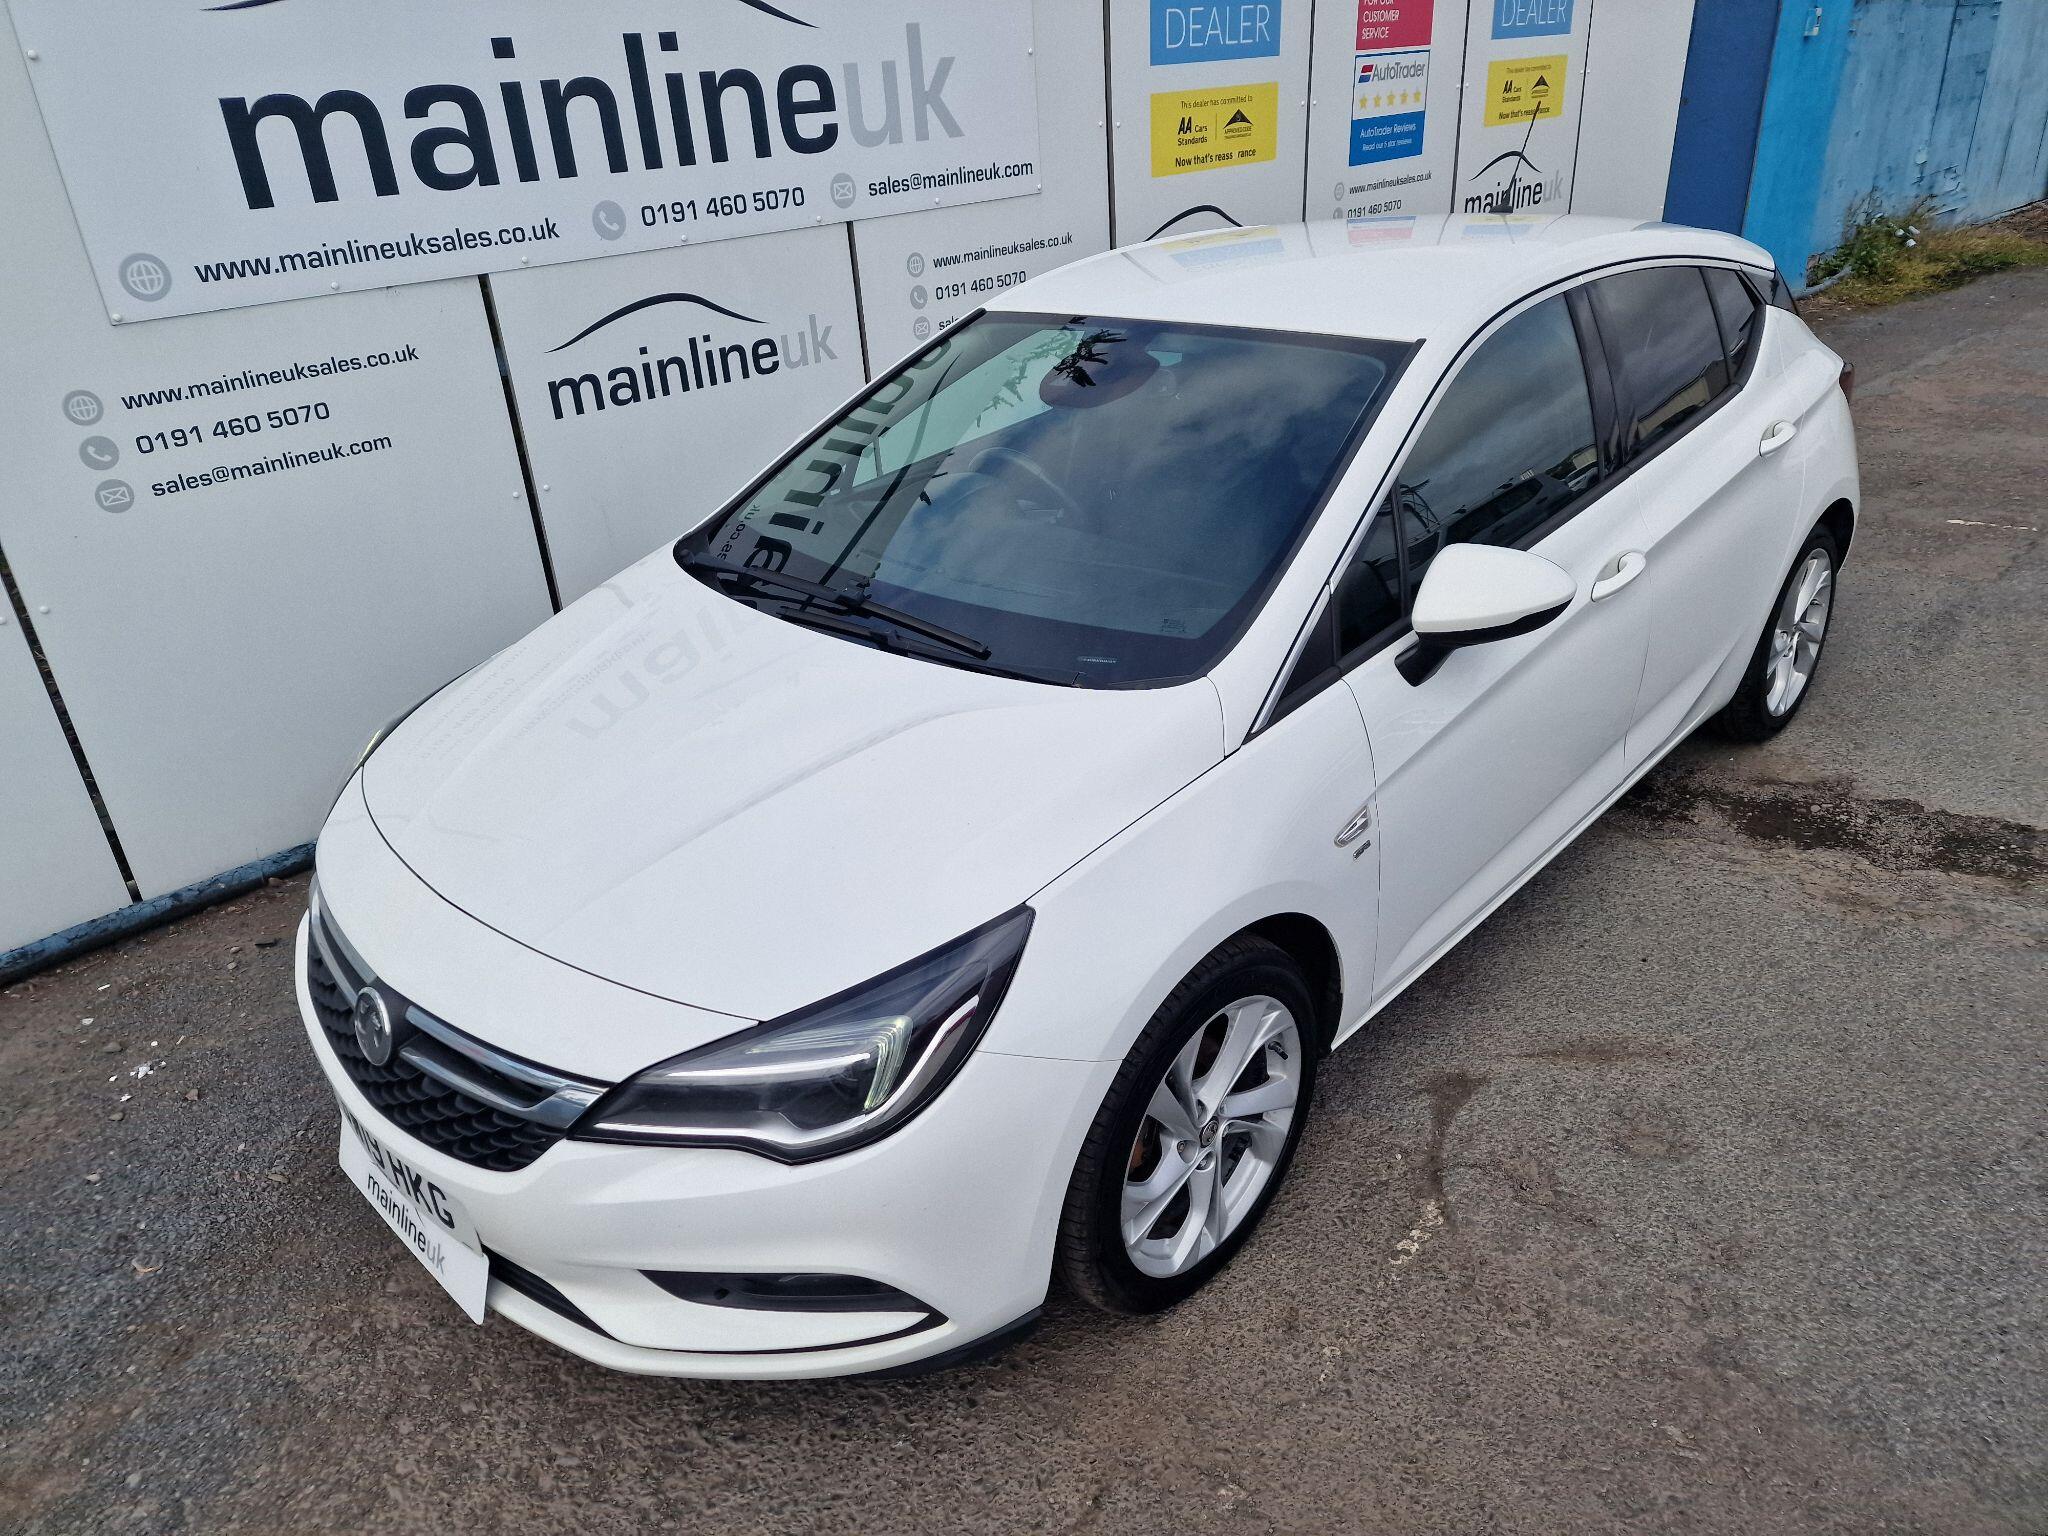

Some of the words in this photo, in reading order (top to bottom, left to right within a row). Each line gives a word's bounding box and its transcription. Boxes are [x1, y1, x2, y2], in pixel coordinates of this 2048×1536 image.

[1165, 4, 1271, 49] DEALER
[1363, 10, 1400, 23] CUSTOMER
[1501, 0, 1567, 27] DEALER
[1362, 26, 1390, 40] SERVICE
[1372, 61, 1426, 82] AutoTrader
[219, 22, 964, 209] mainlineuk
[1181, 100, 1192, 109] This
[1193, 99, 1209, 108] dealer
[1210, 98, 1219, 106] has
[1220, 95, 1247, 105] committed
[1177, 116, 1192, 135] AA
[1194, 124, 1208, 133] Cars
[1177, 135, 1208, 146] Standards
[1360, 126, 1393, 139] AutoTrader
[1394, 122, 1417, 134] Reviews
[1175, 156, 1192, 168] Now
[1193, 152, 1214, 165] that's
[868, 160, 1034, 196] sales@mainlineuk.com
[1349, 170, 1432, 194] www.mainlineuksales.co.uk
[641, 197, 698, 227] 0191
[706, 194, 747, 218] 460
[753, 186, 805, 213] 5070
[1347, 206, 1366, 218] 0191
[1368, 203, 1382, 215] 460
[1383, 199, 1402, 212] 5070
[194, 218, 560, 283] www.mainlineuksales.co.uk
[932, 232, 1073, 270] www.mainlineuksales.co.uk
[935, 279, 967, 301] 0191
[970, 275, 995, 297] 460
[996, 270, 1027, 290] 5070
[121, 344, 419, 410] www.mainlineuksales.co.uk
[547, 314, 839, 420] mainlineuk
[135, 425, 203, 454] 0191
[212, 414, 262, 440] 460
[267, 402, 331, 430] 5070
[151, 435, 393, 497] sales@mainlineuk.com
[386, 1150, 455, 1229] HKG
[367, 1172, 445, 1275] mainlineuk
